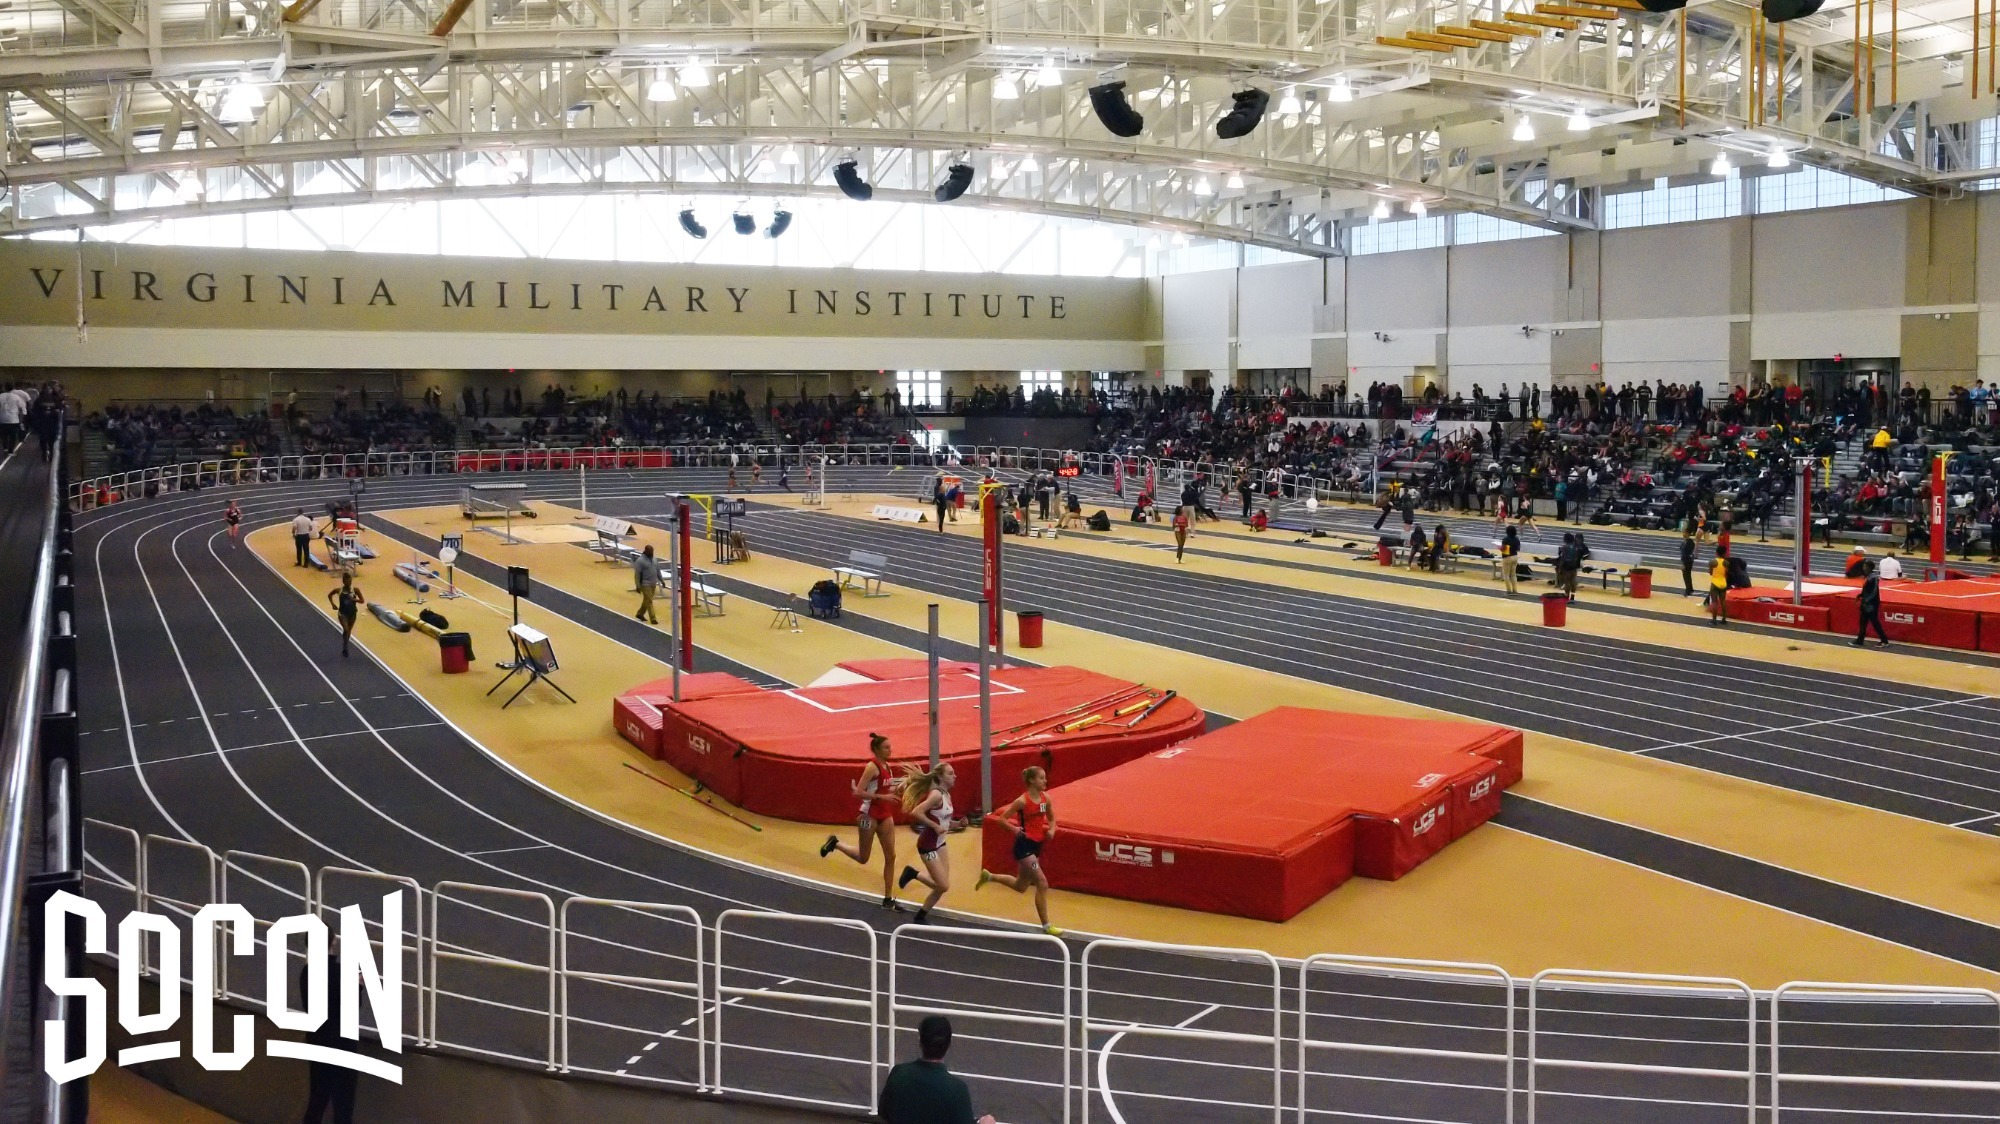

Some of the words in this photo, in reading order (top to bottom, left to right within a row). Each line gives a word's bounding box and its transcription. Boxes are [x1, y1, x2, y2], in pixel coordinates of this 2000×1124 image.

[29, 268, 397, 306] VIRGINIA
[442, 280, 749, 314] MILITARY
[788, 289, 1066, 319] INSTITUTE
[1769, 611, 1795, 622] UCS
[1884, 611, 1914, 623] UCS
[1469, 776, 1490, 800] UCS
[1413, 807, 1436, 834] UCS
[1095, 841, 1153, 862] UCS
